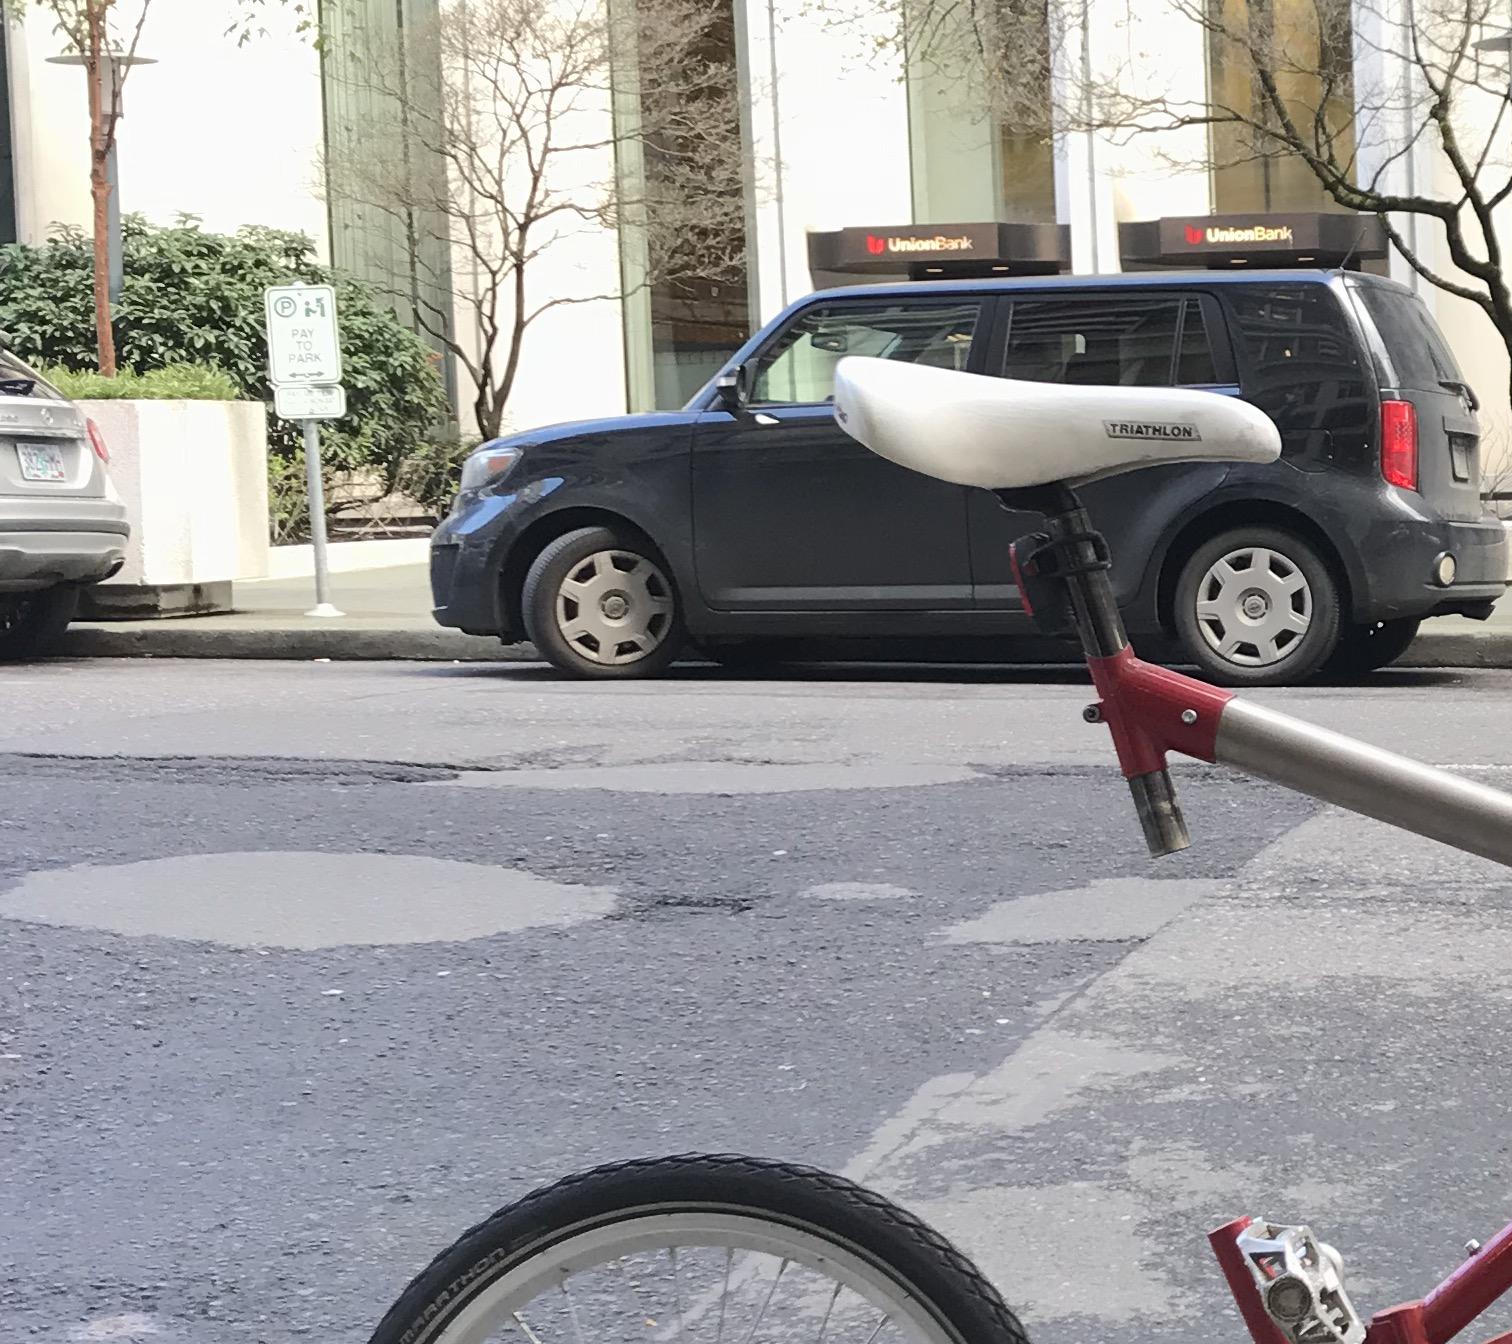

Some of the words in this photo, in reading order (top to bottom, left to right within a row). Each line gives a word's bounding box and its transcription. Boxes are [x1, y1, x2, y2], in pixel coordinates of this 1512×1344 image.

[1206, 226, 1293, 242] UnionBank
[888, 236, 974, 252] UnionBank
[291, 328, 315, 339] PAY
[296, 341, 313, 351] TO
[288, 353, 322, 363] PARK
[1110, 423, 1193, 437] TRIATHLON
